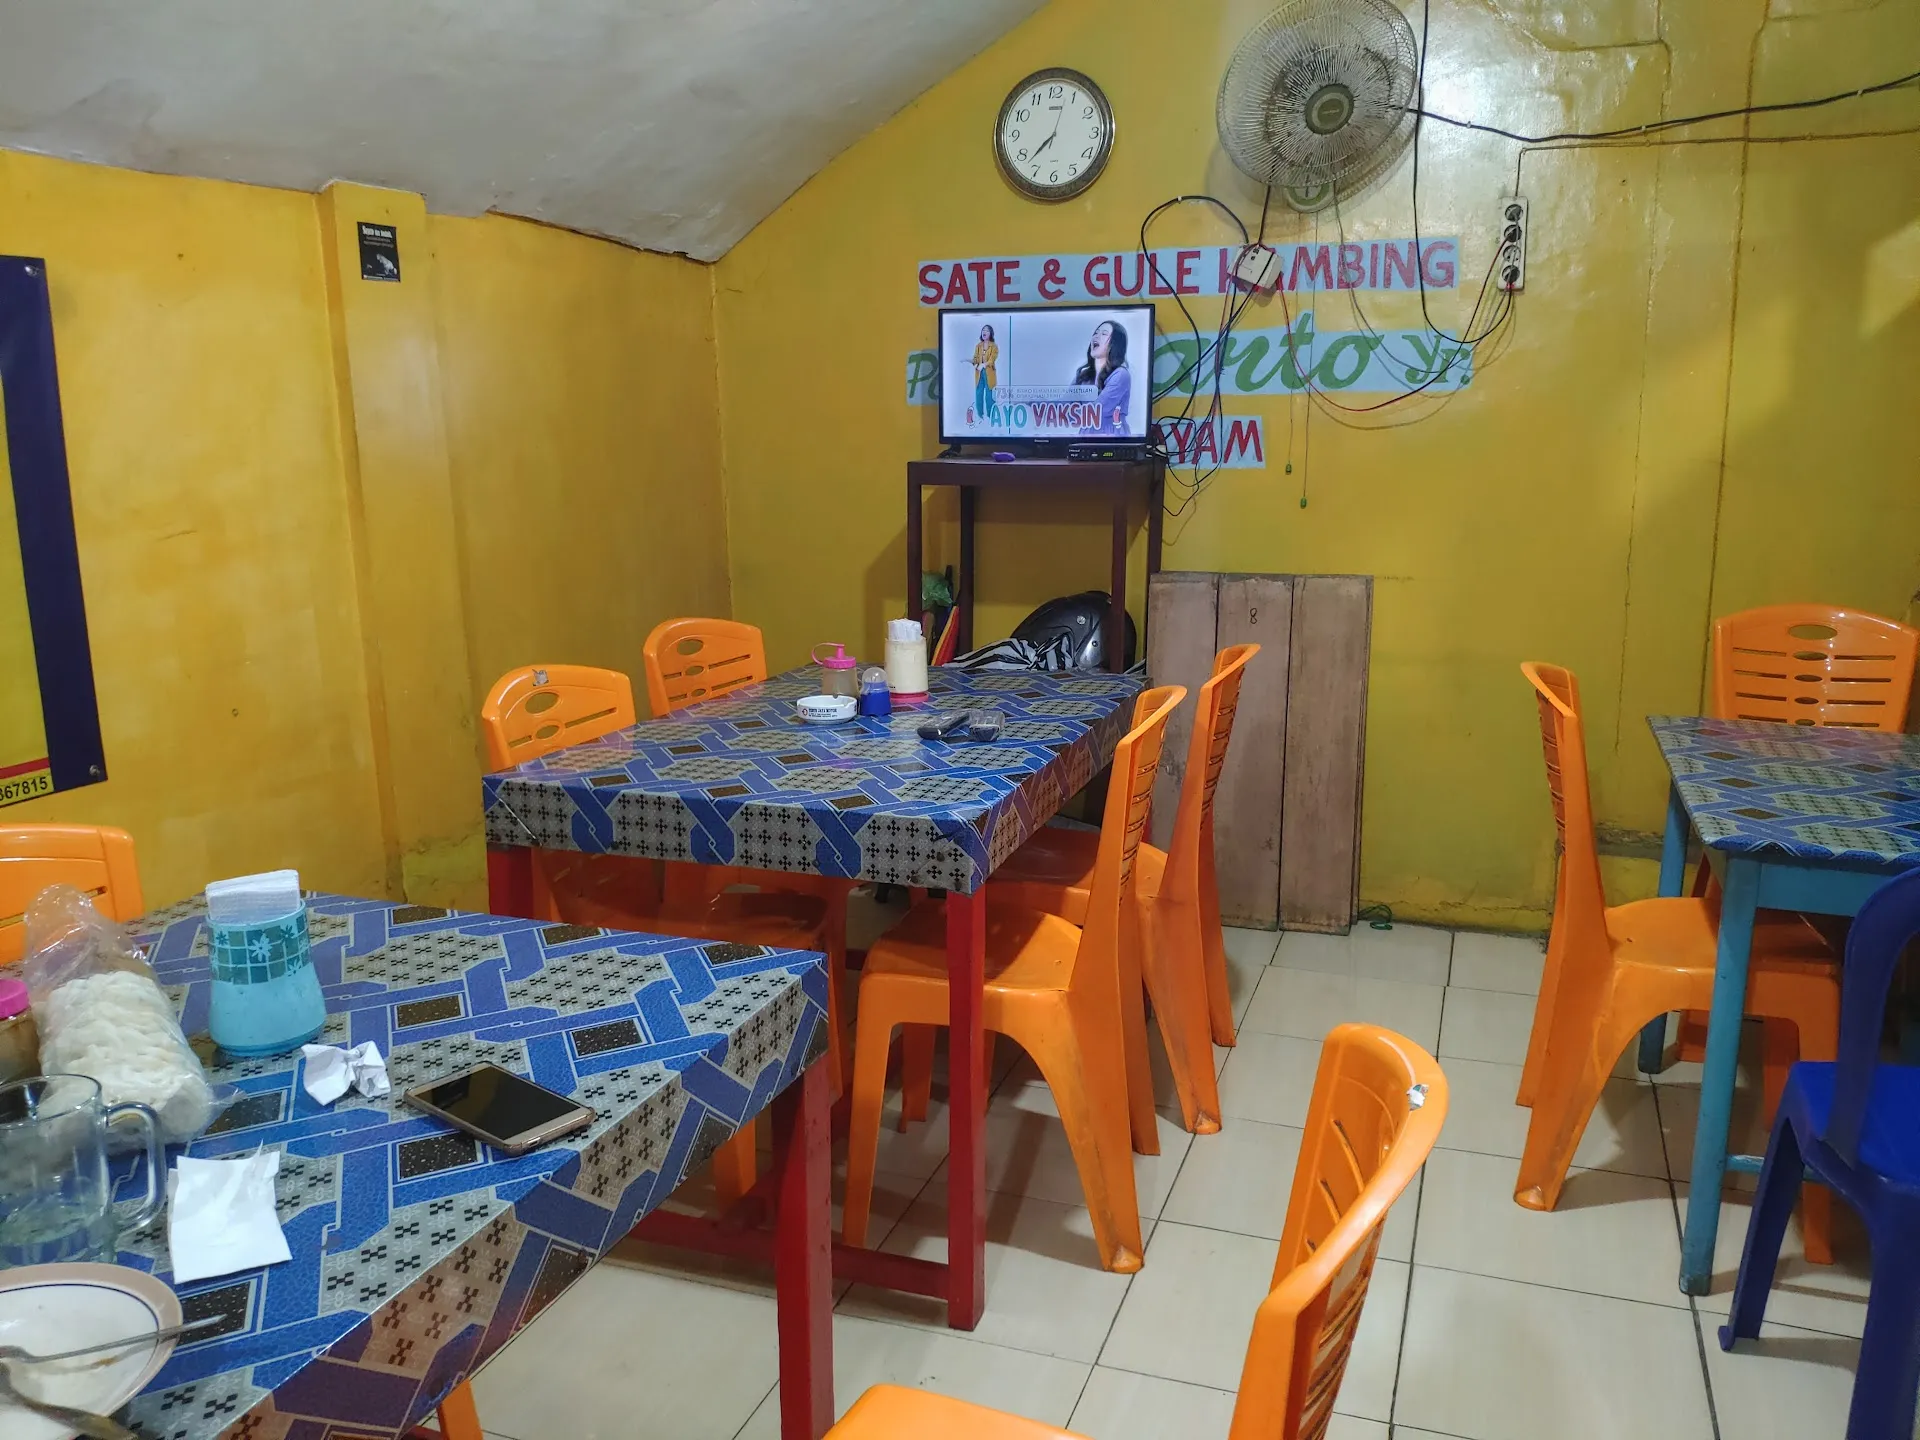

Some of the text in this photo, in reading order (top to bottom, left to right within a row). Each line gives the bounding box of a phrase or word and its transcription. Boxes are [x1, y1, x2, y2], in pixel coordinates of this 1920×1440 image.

[1031, 92, 1042, 106] 11
[1048, 85, 1063, 99] 12
[1071, 91, 1077, 104] 1
[1015, 108, 1031, 122] 10
[1081, 106, 1094, 120] 2
[1011, 129, 1021, 142] 9
[1088, 126, 1100, 140] 3
[1016, 148, 1028, 161] 8
[1081, 146, 1094, 160] 4
[1031, 164, 1041, 178] 7
[1049, 170, 1058, 183] 6
[1067, 163, 1078, 176] 5
[919, 260, 1021, 304] SATE
[1037, 258, 1067, 300] &
[1083, 250, 1201, 298] GULE
[990, 403, 1101, 429] AYO VAKSIN
[1250, 607, 1258, 625] 8
